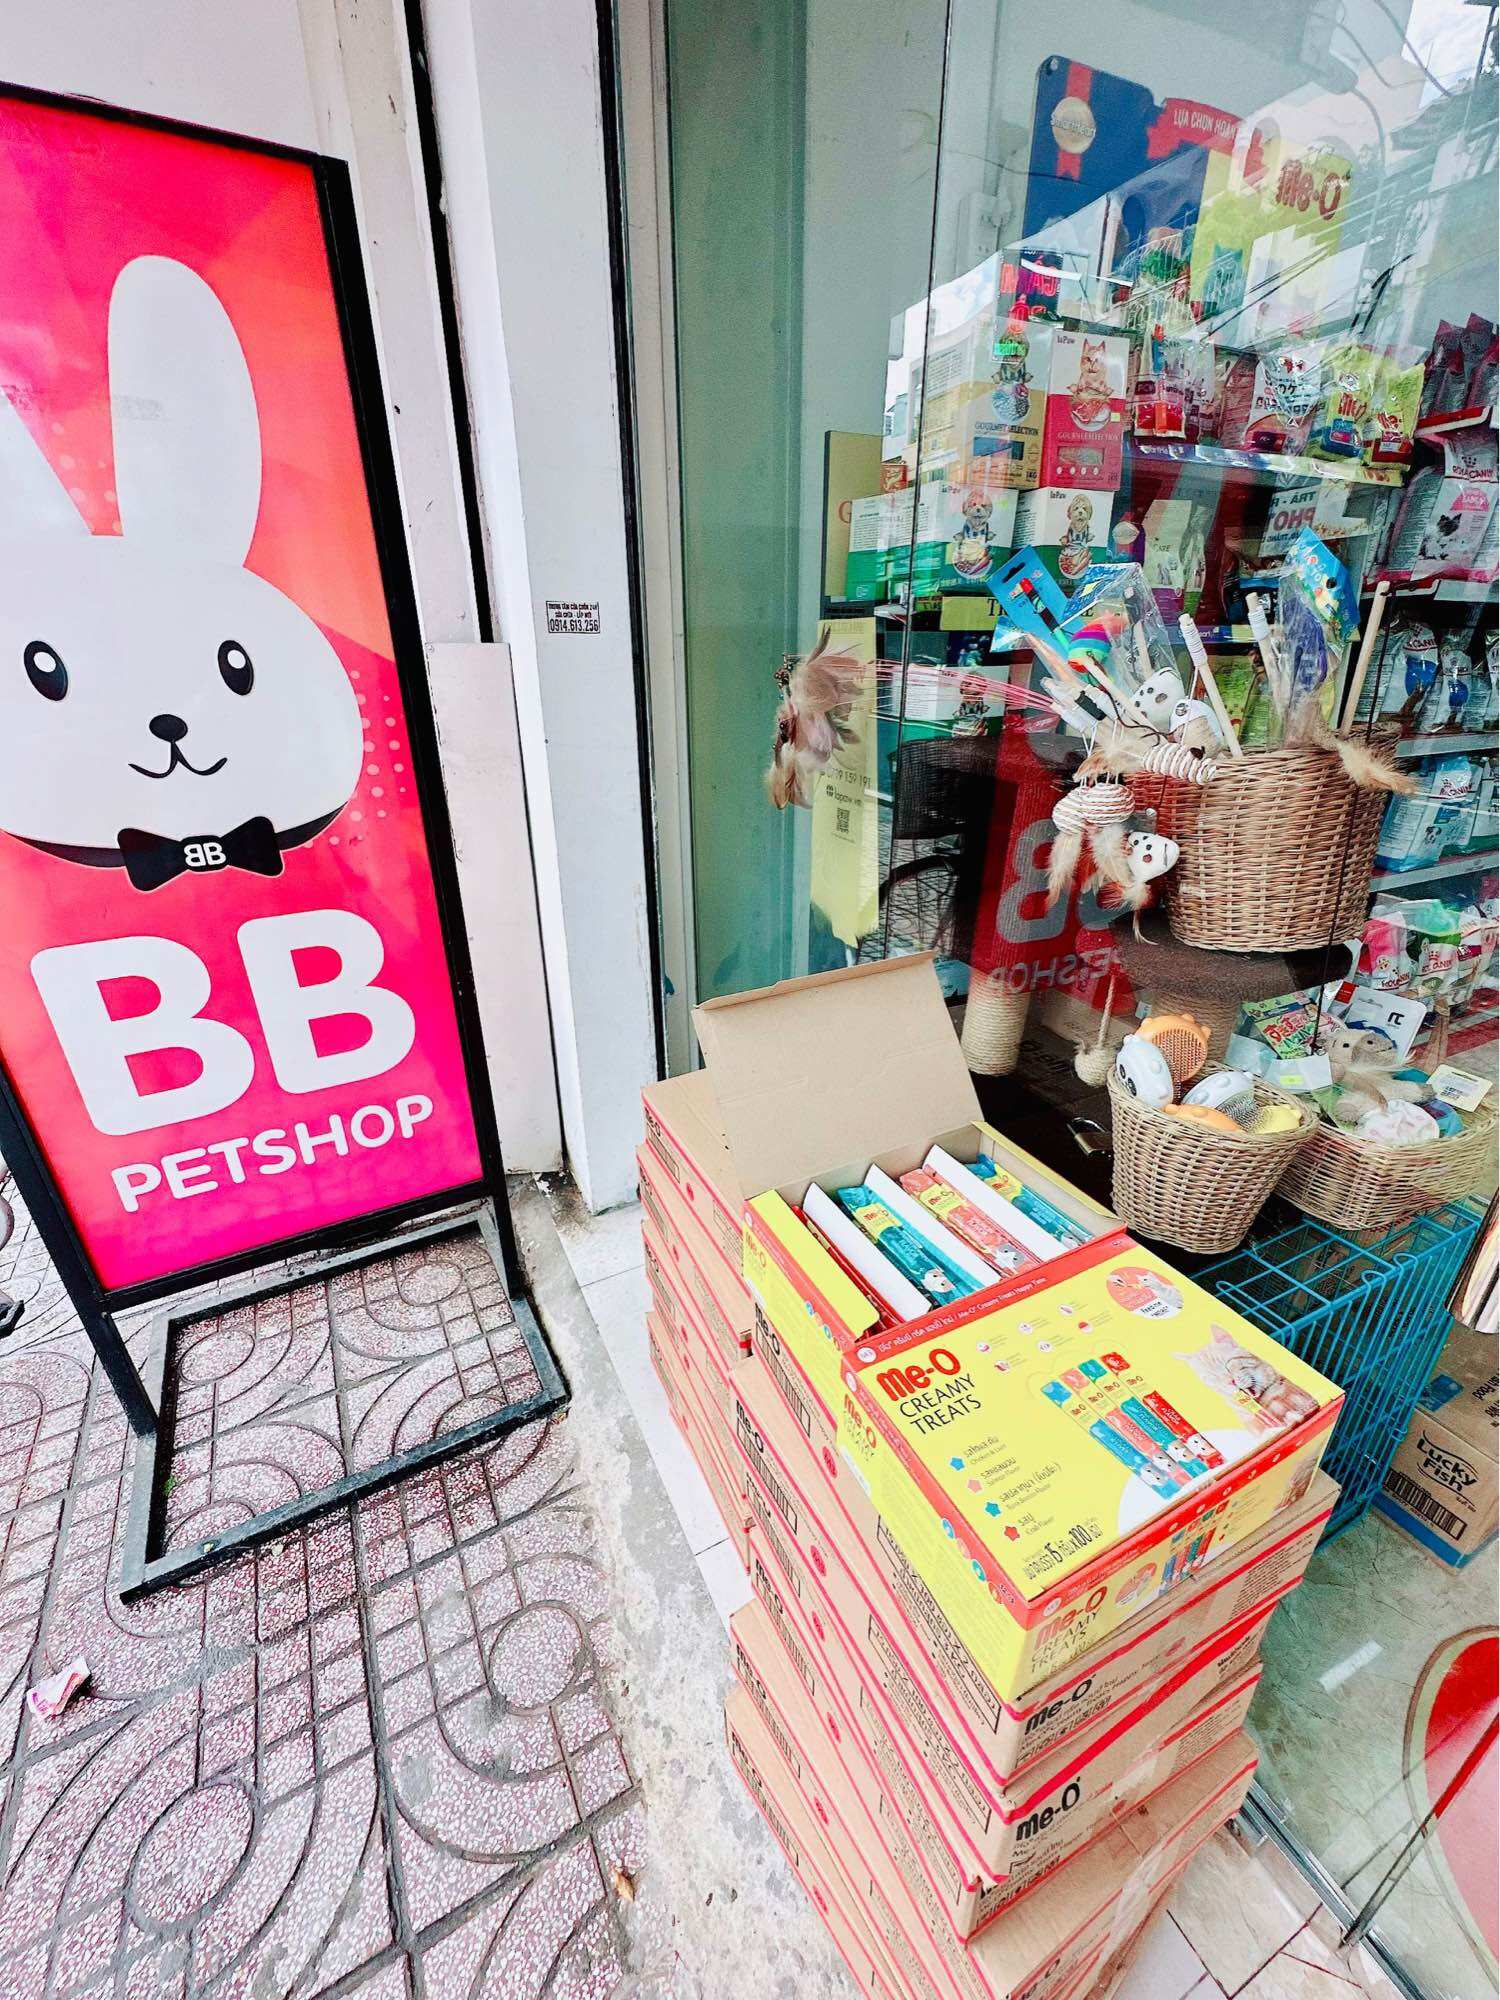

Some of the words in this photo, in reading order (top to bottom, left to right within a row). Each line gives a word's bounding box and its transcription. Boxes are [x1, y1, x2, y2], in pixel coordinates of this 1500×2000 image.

[549, 618, 599, 632] 0914.613.256
[30, 909, 417, 1136] BB
[111, 1094, 434, 1213] PETSHOP
[899, 1372, 976, 1418] CREAMY
[910, 1394, 982, 1436] TREATS
[1416, 1438, 1478, 1487] Lucky
[1422, 1457, 1463, 1492] Fish
[1032, 1611, 1098, 1663] CREAMY
